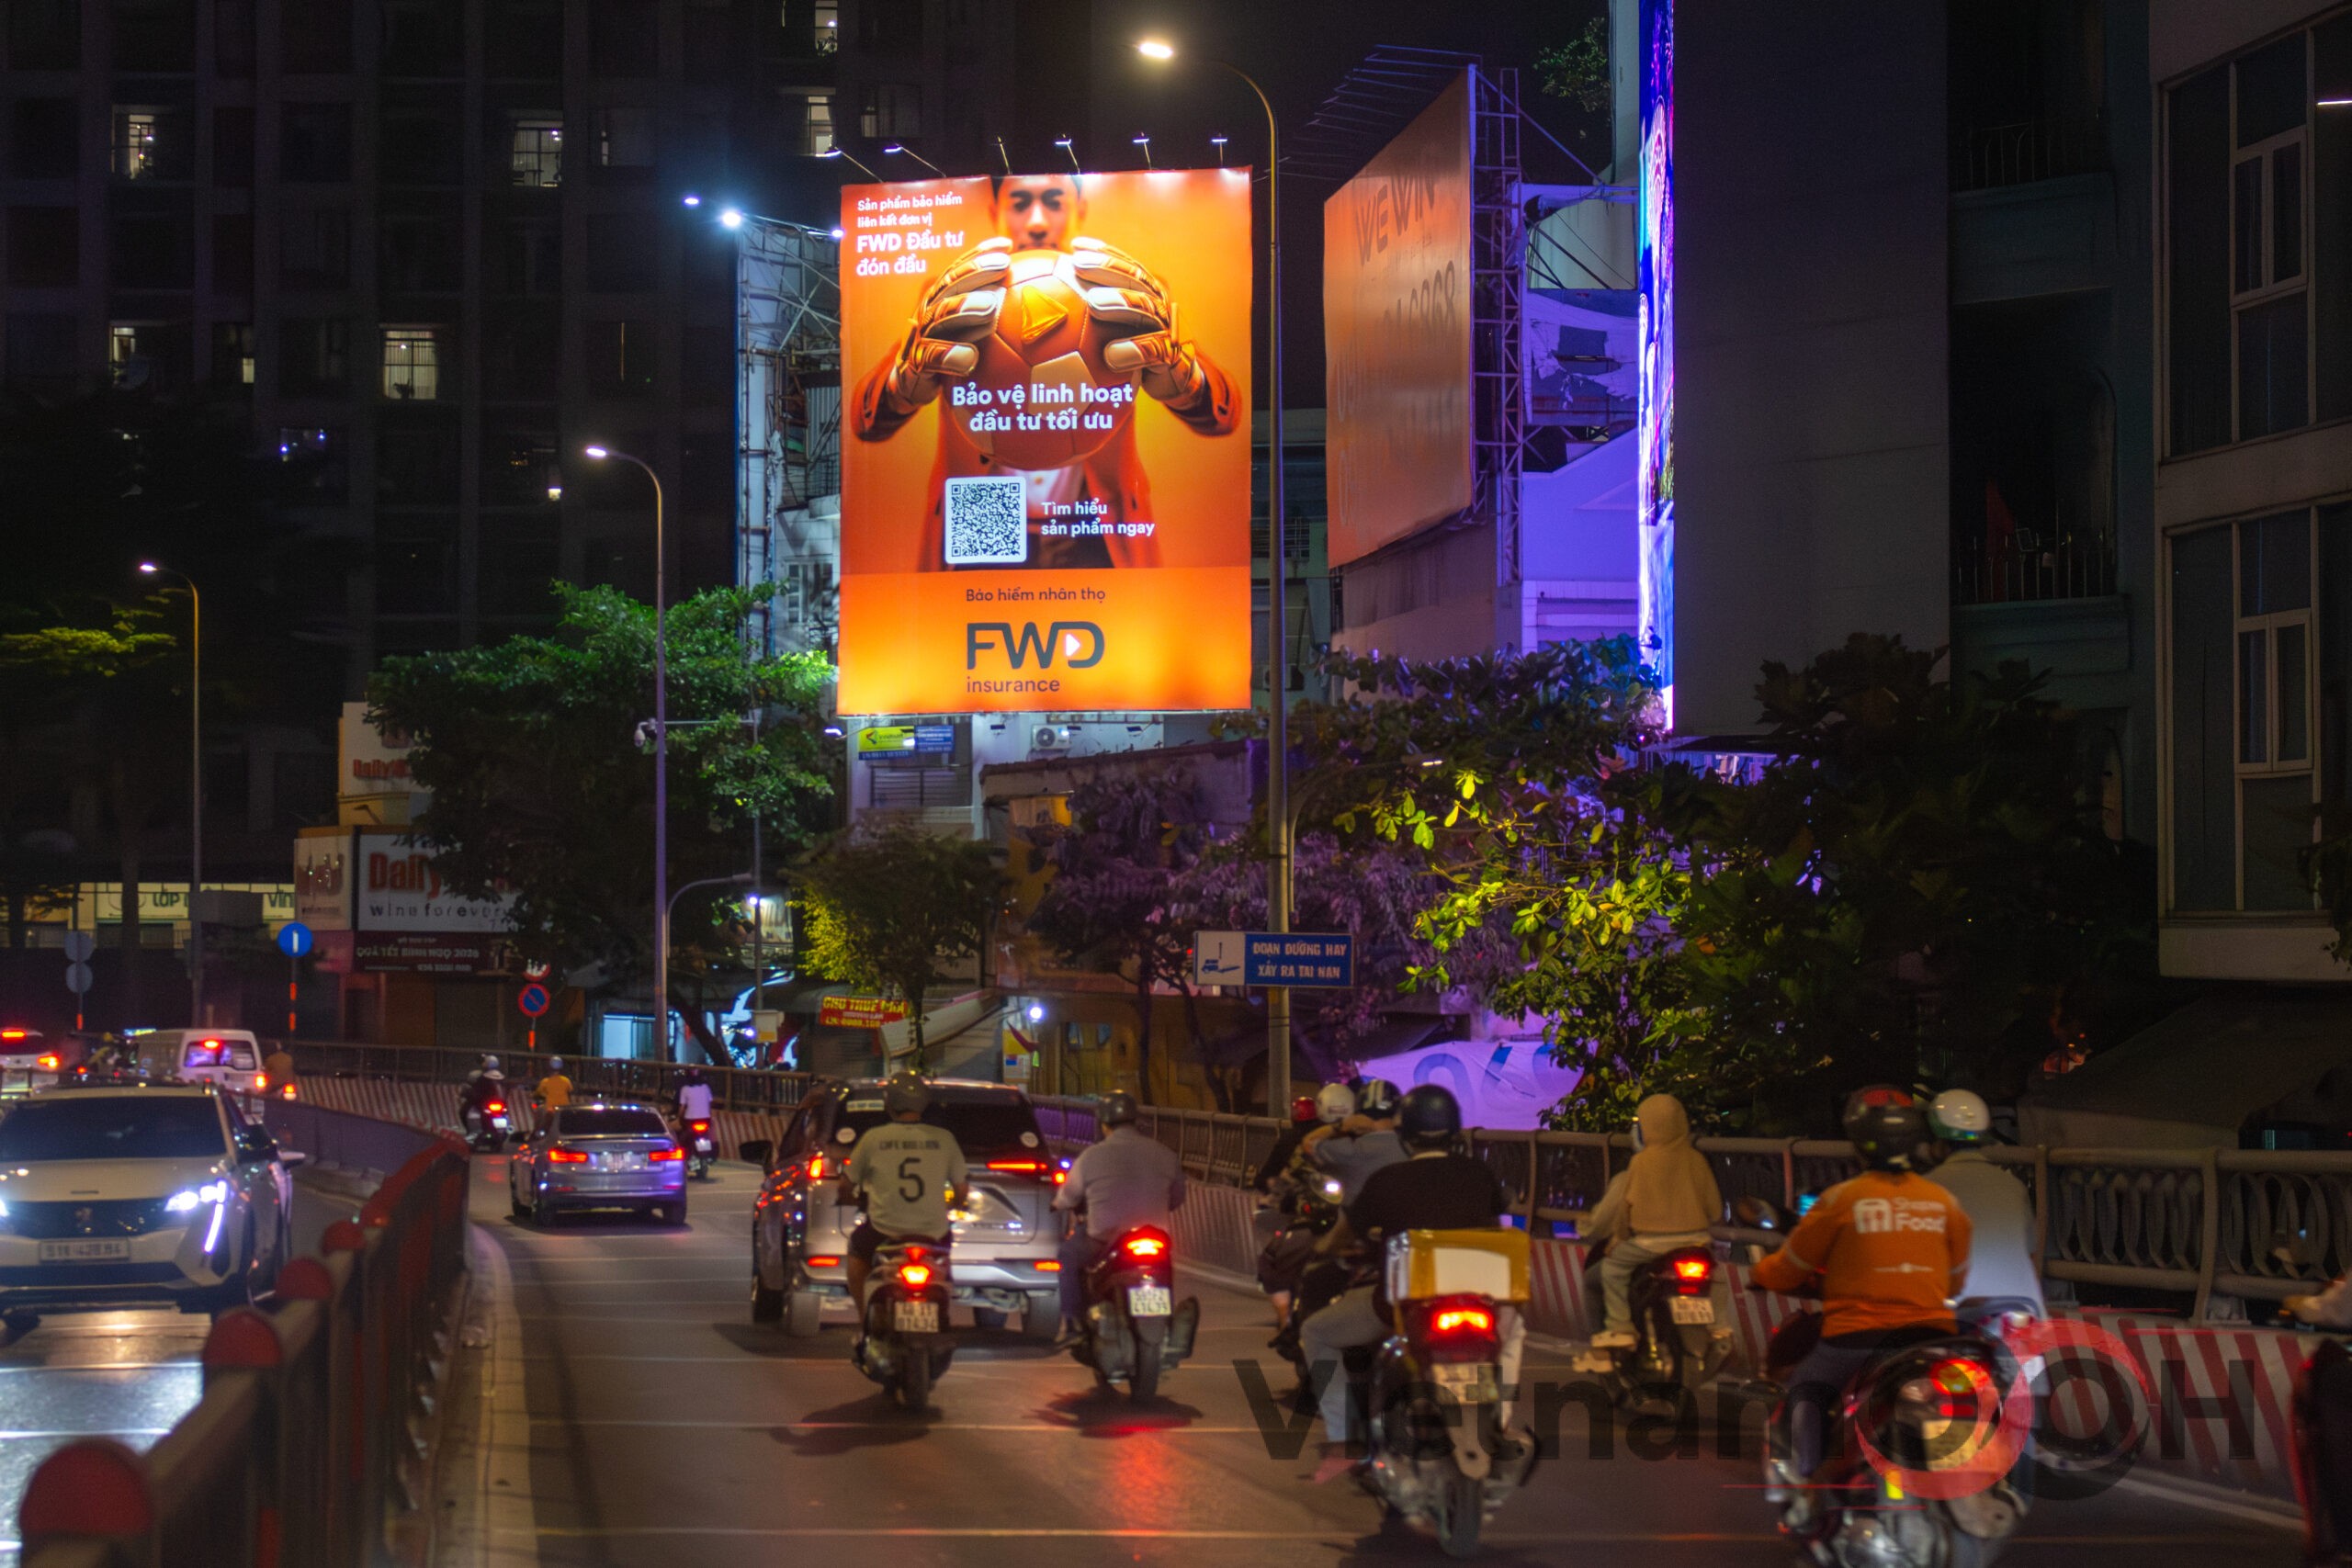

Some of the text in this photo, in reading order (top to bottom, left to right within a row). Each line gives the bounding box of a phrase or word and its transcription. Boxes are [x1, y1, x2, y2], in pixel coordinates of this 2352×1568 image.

[857, 191, 962, 211] Sản phẩm bảo hiểm
[857, 211, 933, 228] liên kết đơn vị
[856, 229, 964, 253] FWD Đầu tư
[856, 253, 926, 276] đón đầu
[952, 381, 1133, 410] Bảo vệ linh hoạt
[969, 407, 1113, 432] đầu tư tối ưu
[1041, 497, 1108, 515] Tìm hiểu
[1041, 517, 1156, 538] sản phẩm ngay
[997, 586, 1035, 602] hiểm
[1038, 587, 1077, 600] nhân
[1080, 587, 1106, 604] thọ
[967, 621, 1105, 670] FWD
[967, 675, 1060, 693] insurance
[1325, 943, 1347, 956] HAY
[898, 1157, 924, 1202] 5
